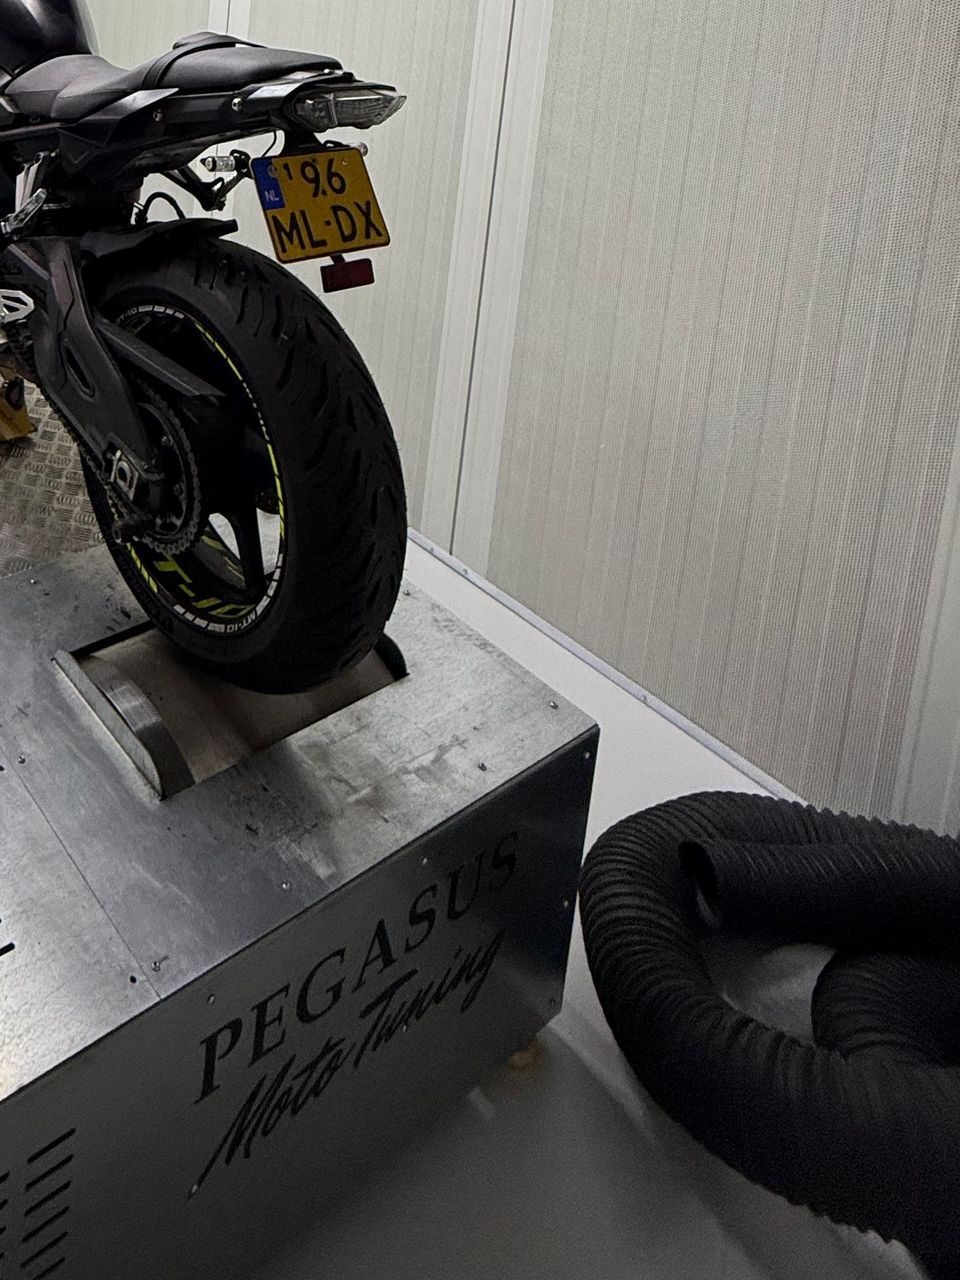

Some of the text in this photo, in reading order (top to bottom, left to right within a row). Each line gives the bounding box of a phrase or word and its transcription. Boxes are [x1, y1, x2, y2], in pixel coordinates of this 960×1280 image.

[264, 189, 281, 202] NL
[226, 608, 258, 633] MT-10
[194, 830, 518, 1105] PEGASUS
[185, 929, 507, 1203] Moto Tuning
